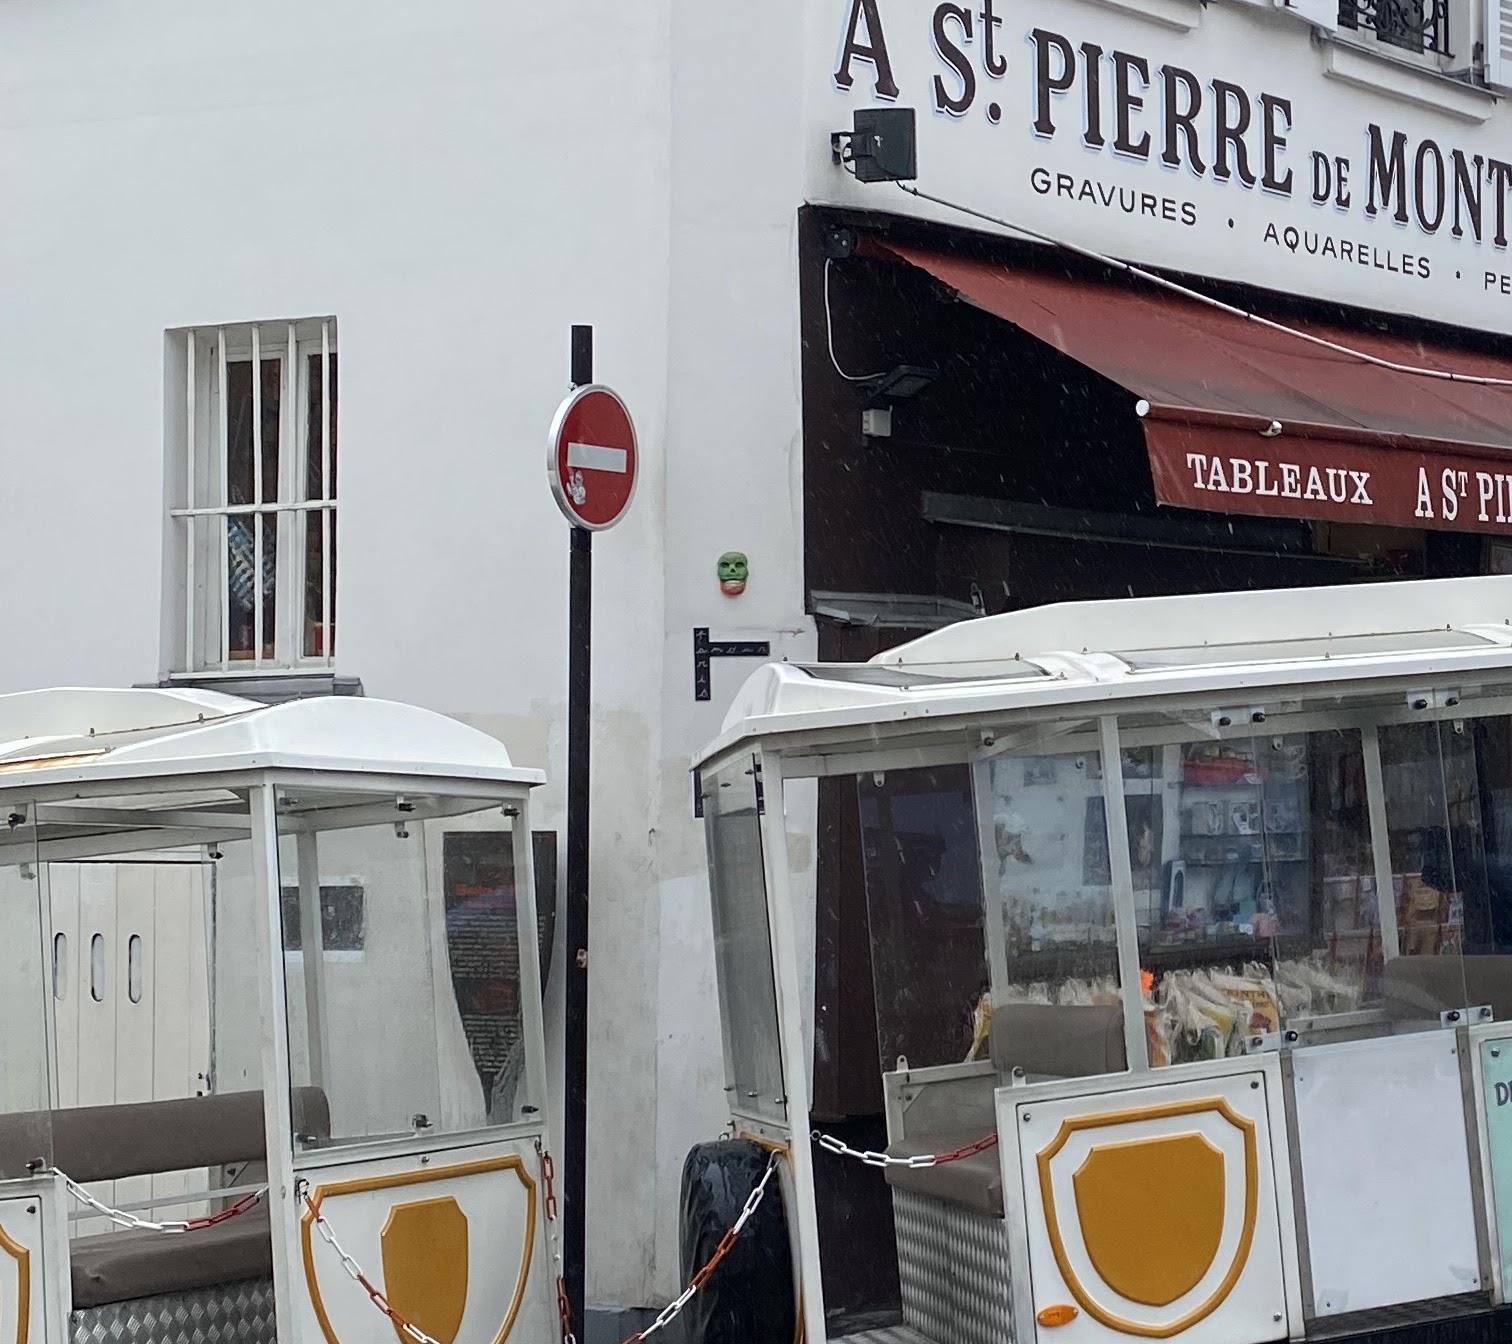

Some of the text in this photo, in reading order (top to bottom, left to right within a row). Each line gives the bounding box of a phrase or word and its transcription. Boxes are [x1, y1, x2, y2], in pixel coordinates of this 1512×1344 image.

[1028, 27, 1293, 198] PIERRE
[1310, 149, 1351, 209] DE
[1030, 167, 1197, 227] GRAVURES
[1264, 222, 1431, 280] AQUARELLES
[1186, 452, 1374, 506] TABLEAUX
[1414, 466, 1434, 518] A
